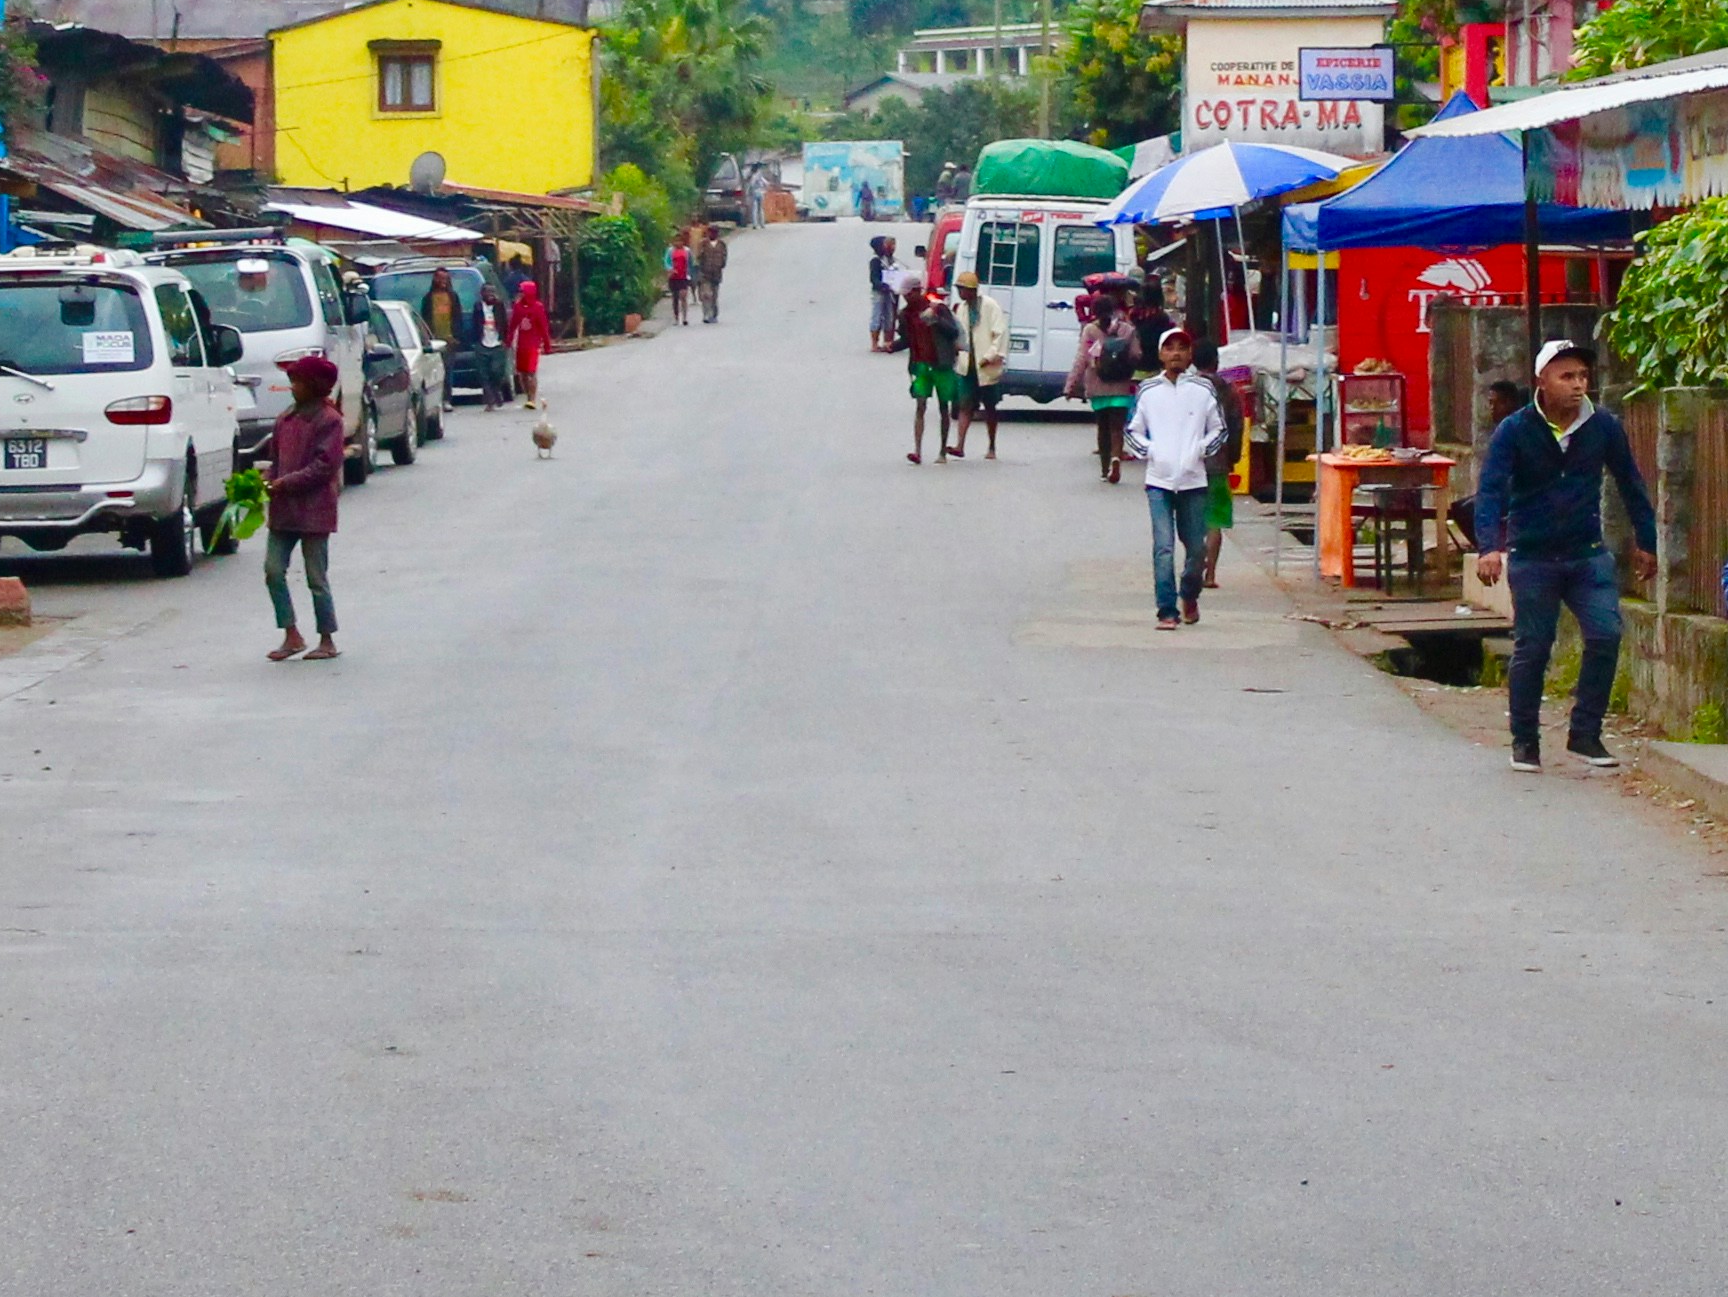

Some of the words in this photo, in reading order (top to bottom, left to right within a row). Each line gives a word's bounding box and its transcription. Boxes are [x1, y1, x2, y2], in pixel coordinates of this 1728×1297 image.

[1210, 61, 1277, 72] COOPERATIVE
[1281, 60, 1295, 72] DE
[1315, 57, 1382, 69] EPICERIE
[1307, 73, 1388, 92] VASSIA
